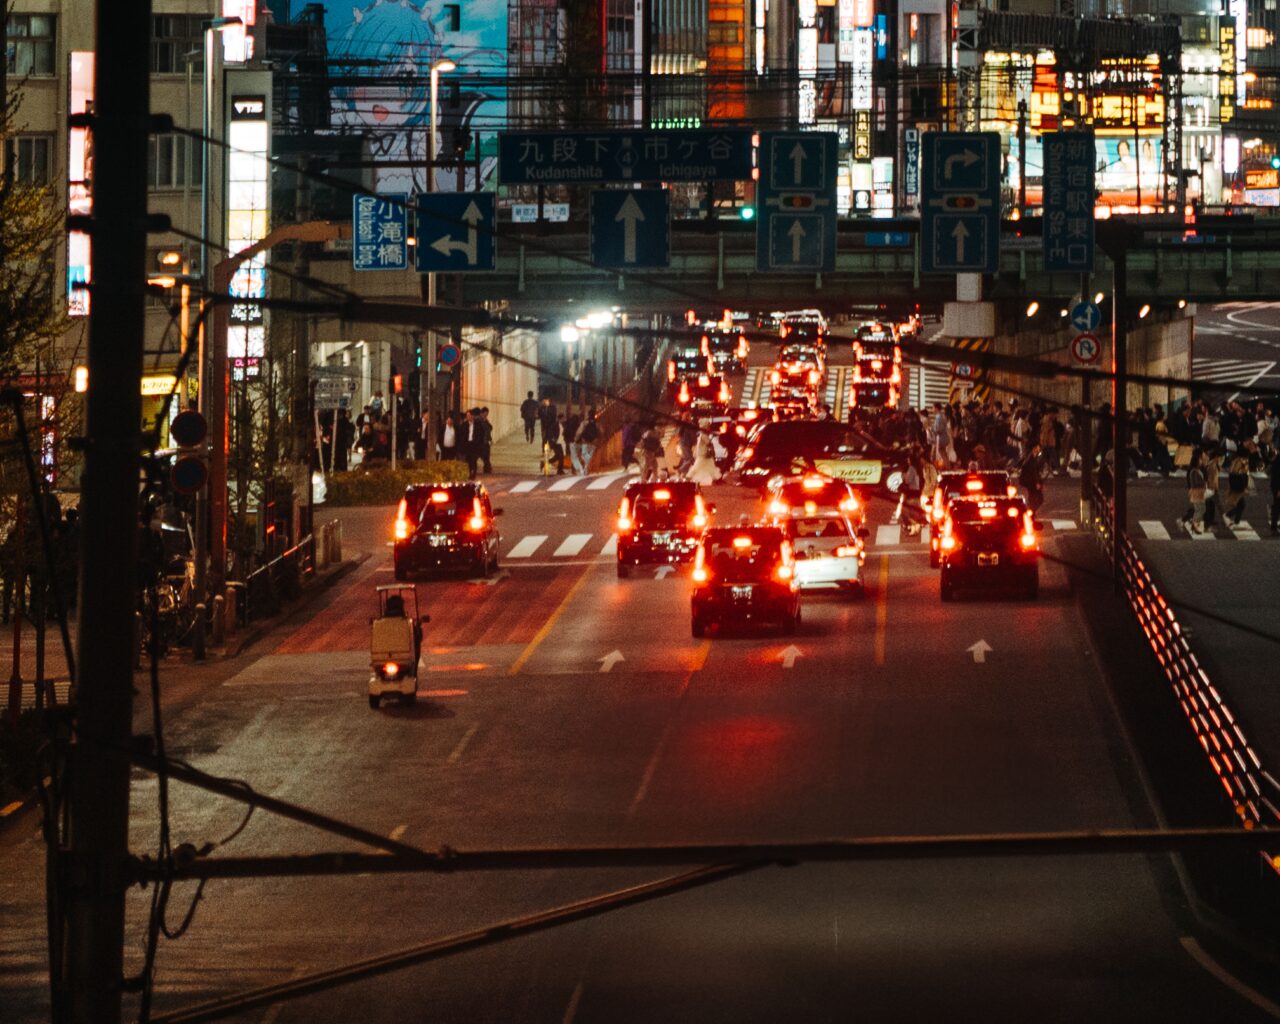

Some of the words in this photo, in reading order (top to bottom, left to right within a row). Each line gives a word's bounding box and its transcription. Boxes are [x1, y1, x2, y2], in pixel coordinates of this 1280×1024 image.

[838, 129, 848, 144] 3F
[519, 137, 611, 163] 九段下
[525, 165, 604, 180] Kudanshita
[659, 163, 717, 181] Ichigaya
[1048, 142, 1065, 206] Shinjuku
[1067, 139, 1089, 265] 新宿駅東口
[376, 199, 403, 266] 小滝橋
